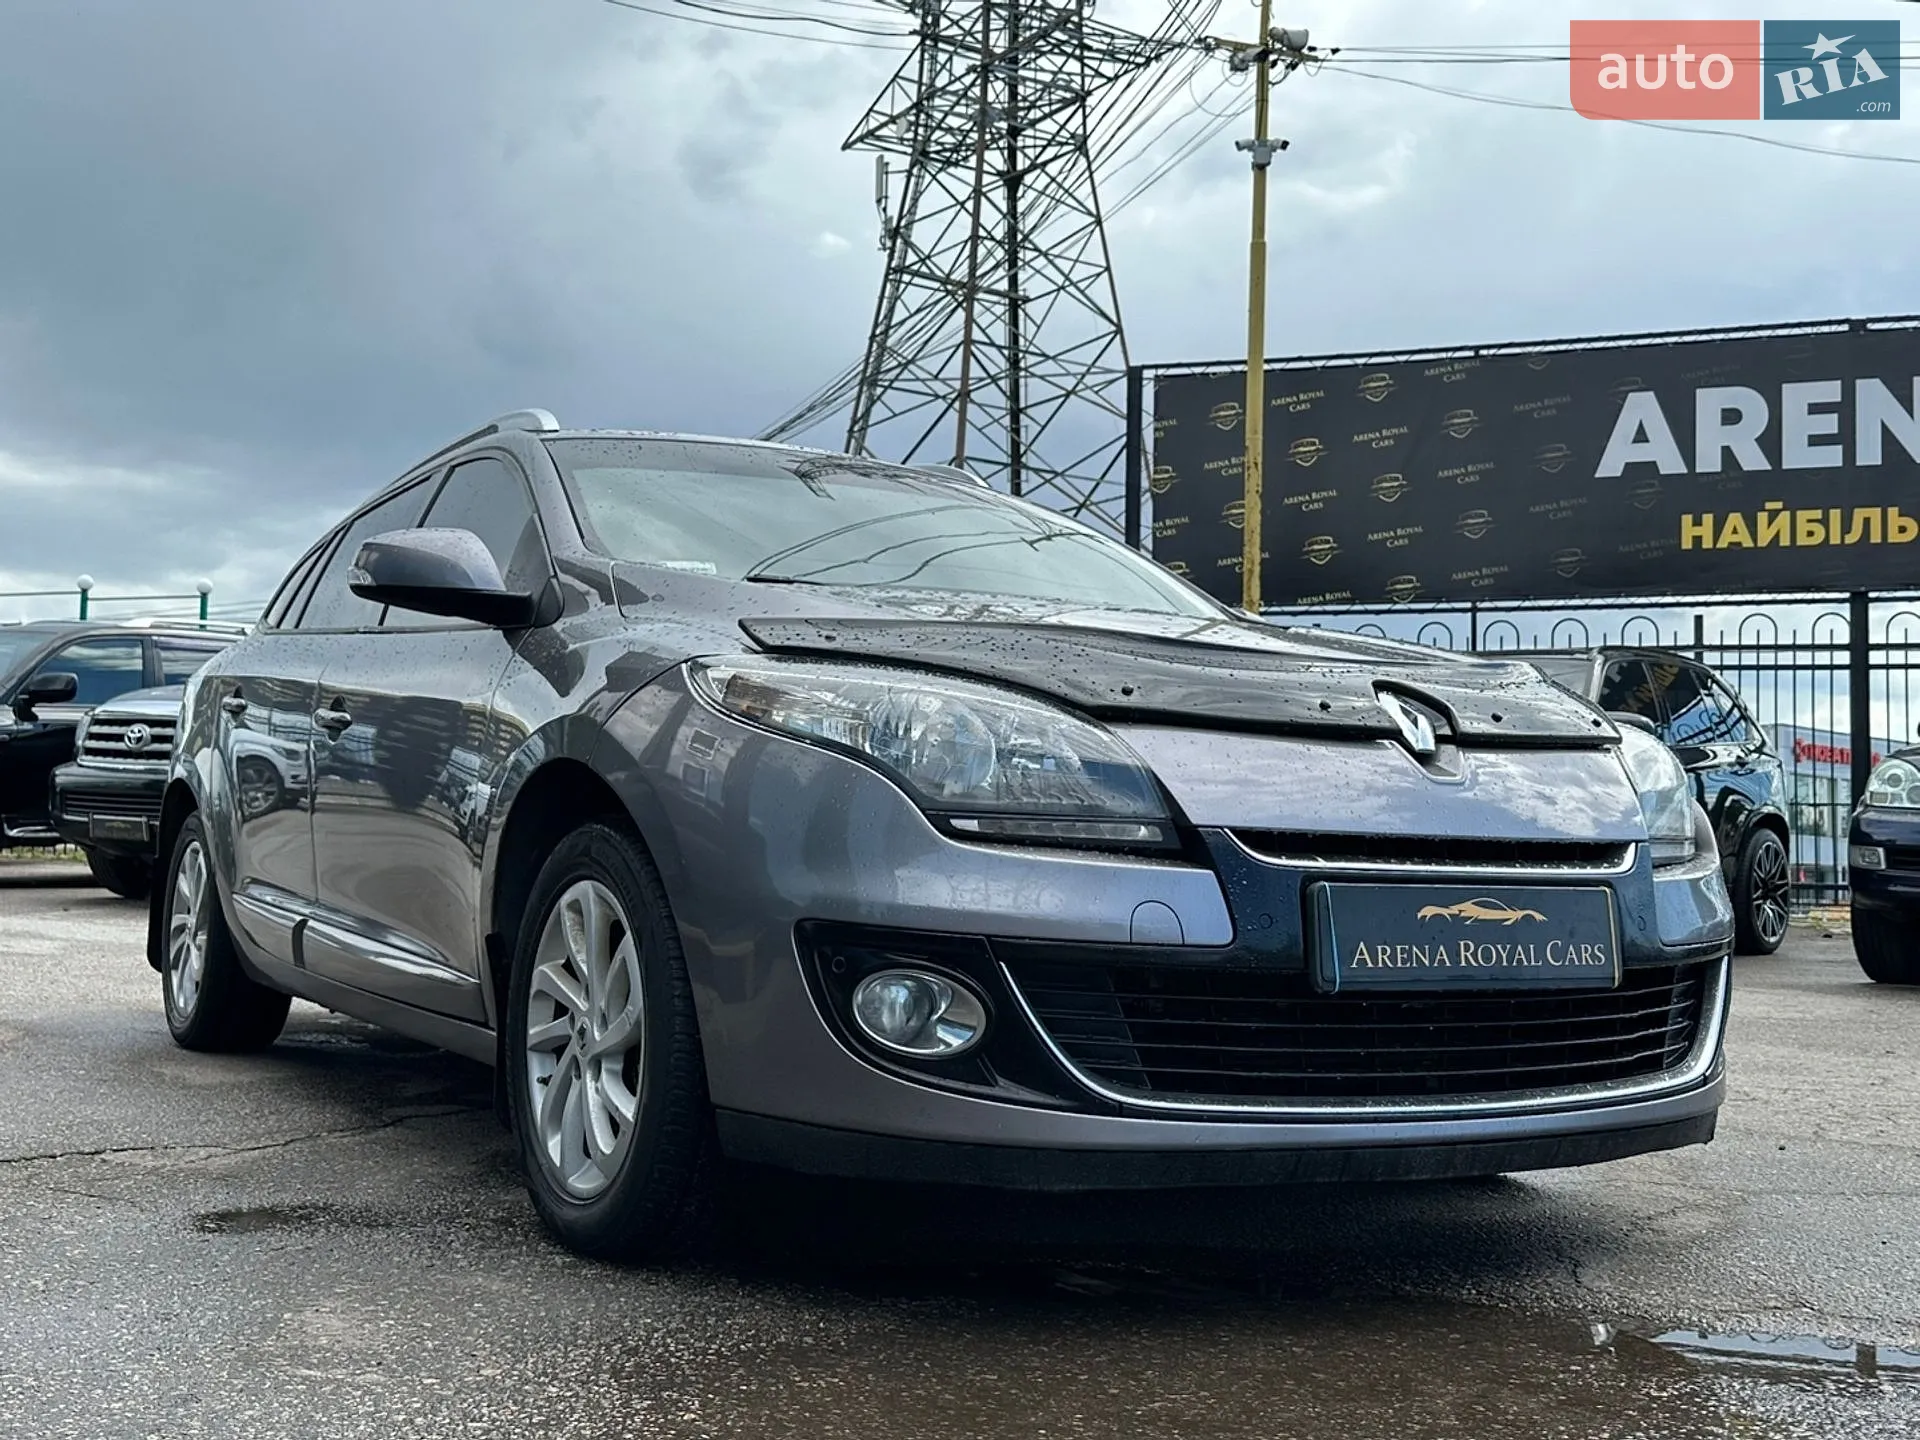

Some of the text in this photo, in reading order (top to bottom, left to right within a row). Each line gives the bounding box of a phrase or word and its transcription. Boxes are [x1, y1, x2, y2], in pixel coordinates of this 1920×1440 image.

[1271, 390, 1325, 407] ARENA ROYAL
[1289, 402, 1311, 412] CARS
[1594, 376, 1920, 478] AREN
[1352, 426, 1409, 443] ARENA ROYAL
[1372, 438, 1395, 448] CARS
[1203, 459, 1230, 470] ARENA
[1437, 461, 1495, 479] ARENA ROYAL
[1456, 474, 1480, 485] CARS
[1282, 489, 1337, 506] ARENA ROYAL
[1301, 501, 1323, 512] CARS
[1165, 515, 1190, 526] ROYAL
[1681, 501, 1919, 550] НАЙБІЛЬ
[1156, 528, 1177, 538] CARS
[1367, 525, 1423, 542] ARENA ROYAL
[1386, 537, 1409, 548] CARS
[1350, 940, 1606, 968] ARENA ROYAL CARS
